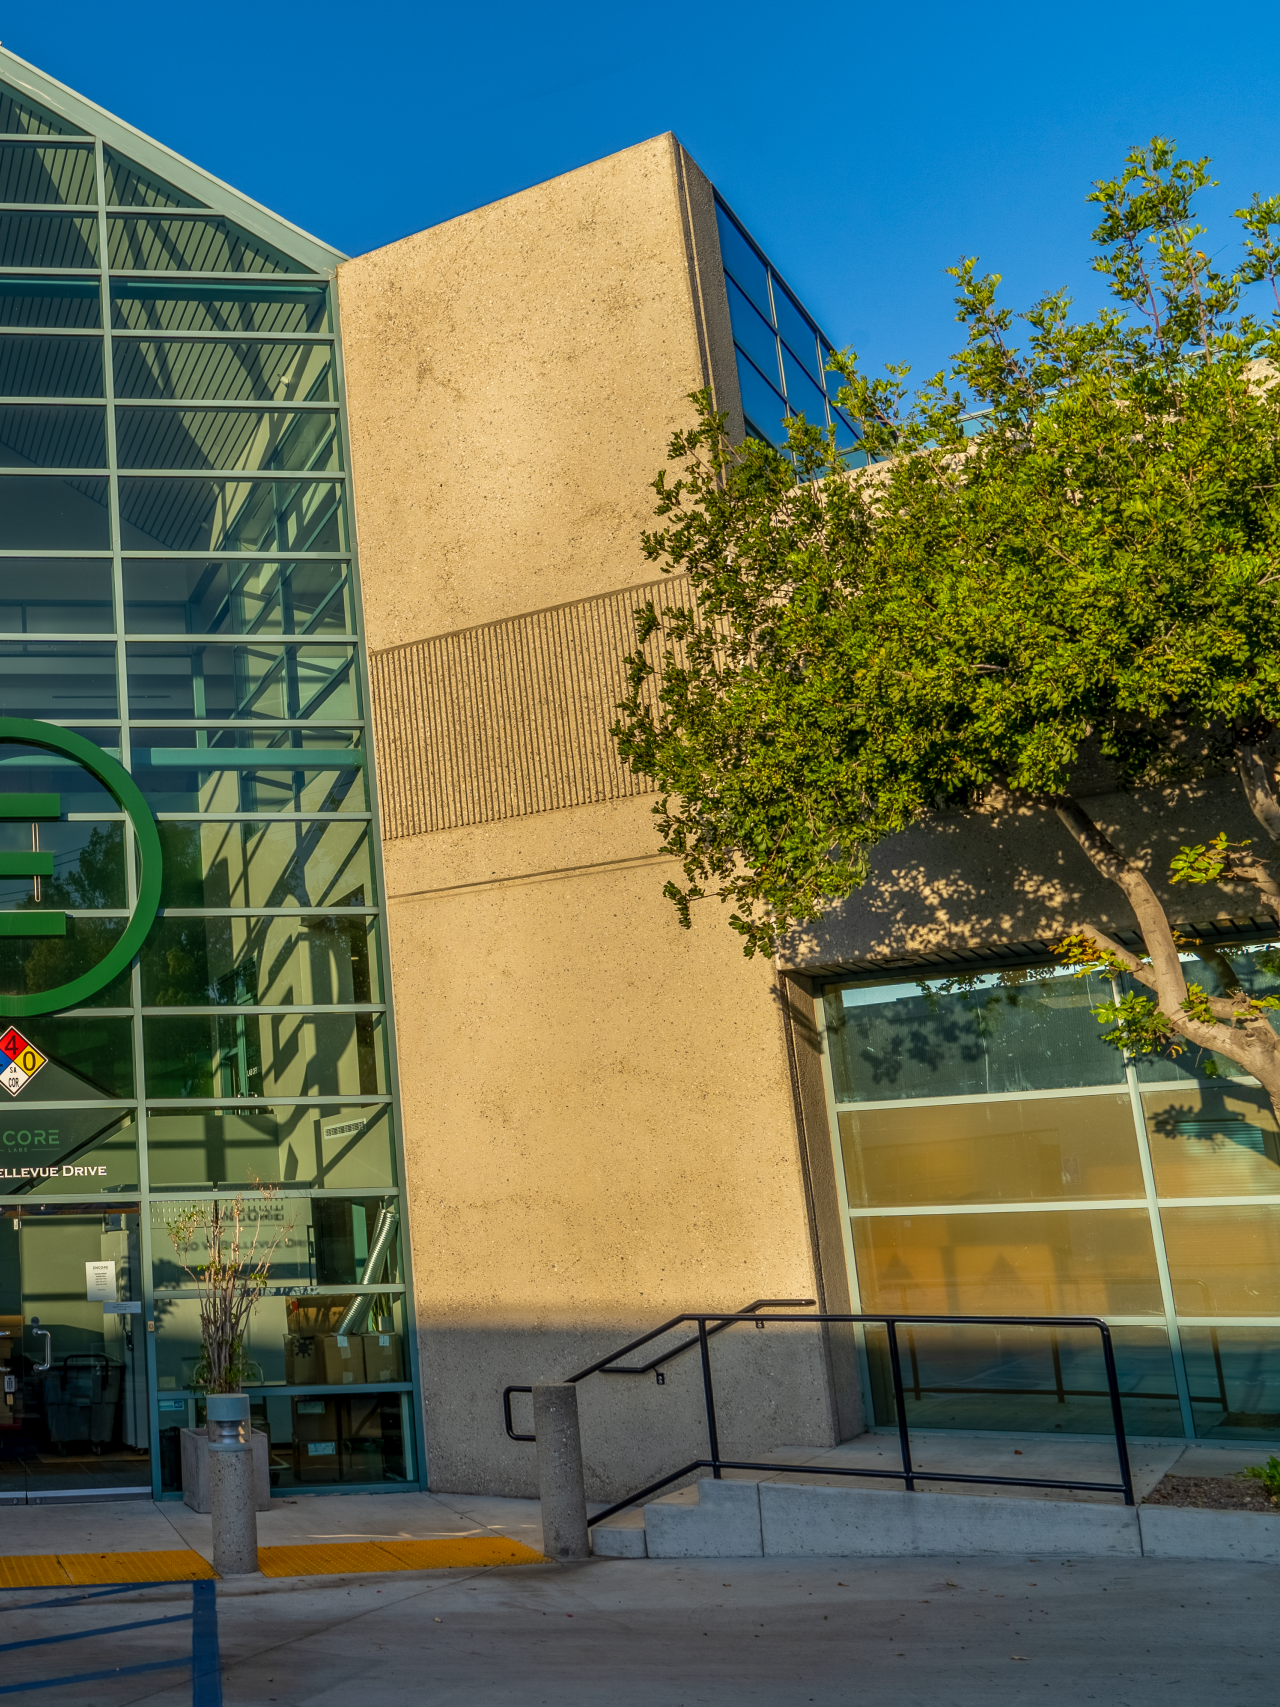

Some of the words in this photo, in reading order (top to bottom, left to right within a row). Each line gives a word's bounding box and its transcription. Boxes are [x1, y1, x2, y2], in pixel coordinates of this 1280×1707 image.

[5, 1035, 19, 1055] 4
[23, 1051, 36, 1071] 0
[8, 1077, 20, 1088] COR
